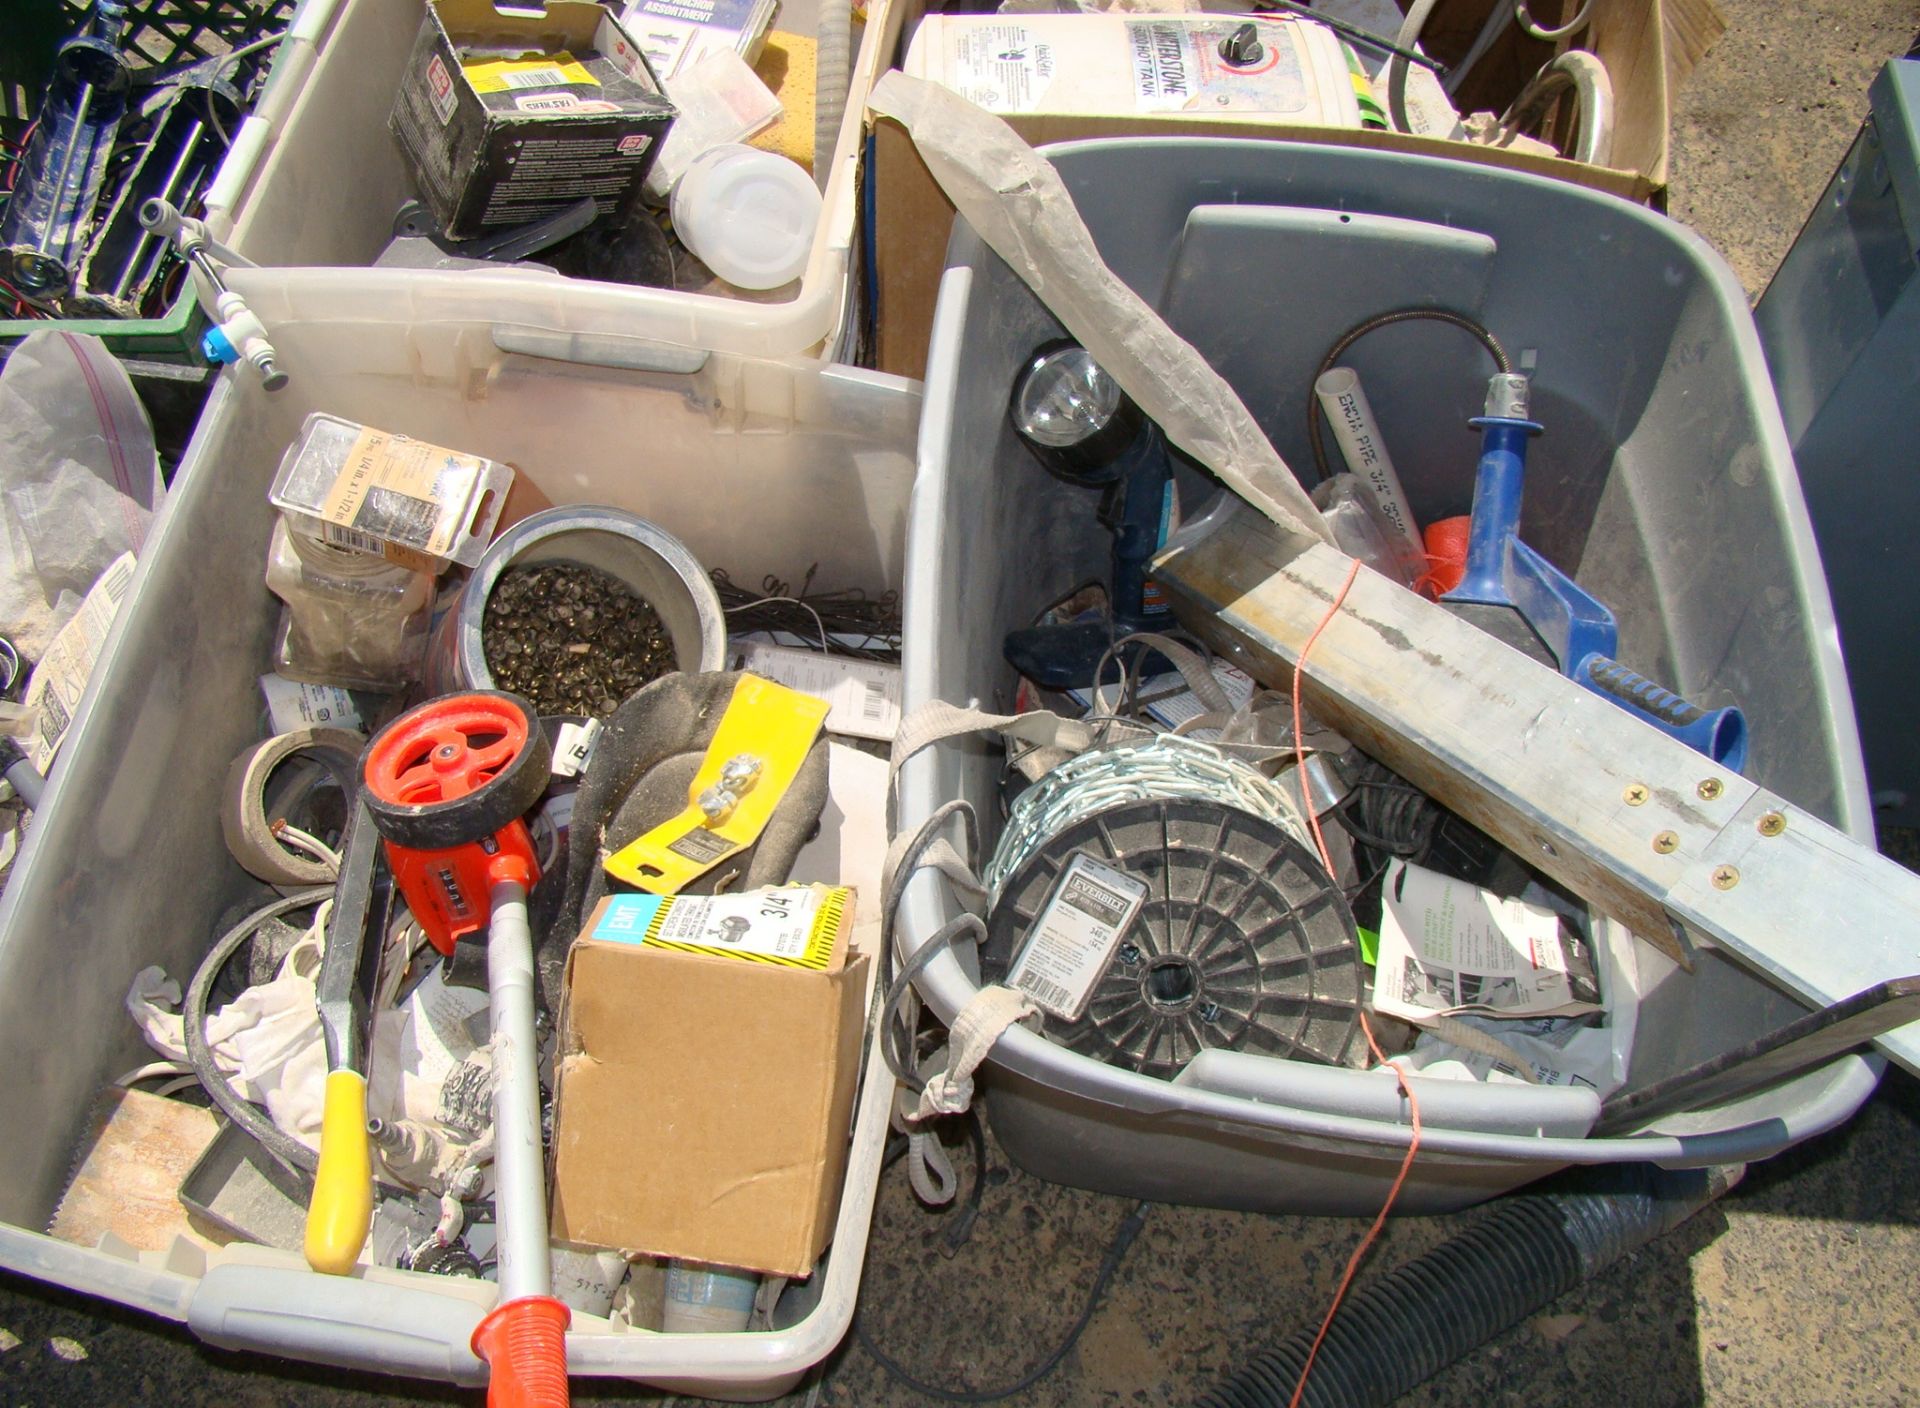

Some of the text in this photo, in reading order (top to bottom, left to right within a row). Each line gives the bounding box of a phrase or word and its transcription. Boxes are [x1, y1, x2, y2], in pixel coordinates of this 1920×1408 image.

[644, 2, 714, 23] ASSORTMENT
[1136, 45, 1151, 63] HOT
[1139, 67, 1155, 97] TANK
[360, 456, 373, 470] 1/4
[1073, 877, 1125, 910] EVERBILT
[607, 904, 642, 929] EMT
